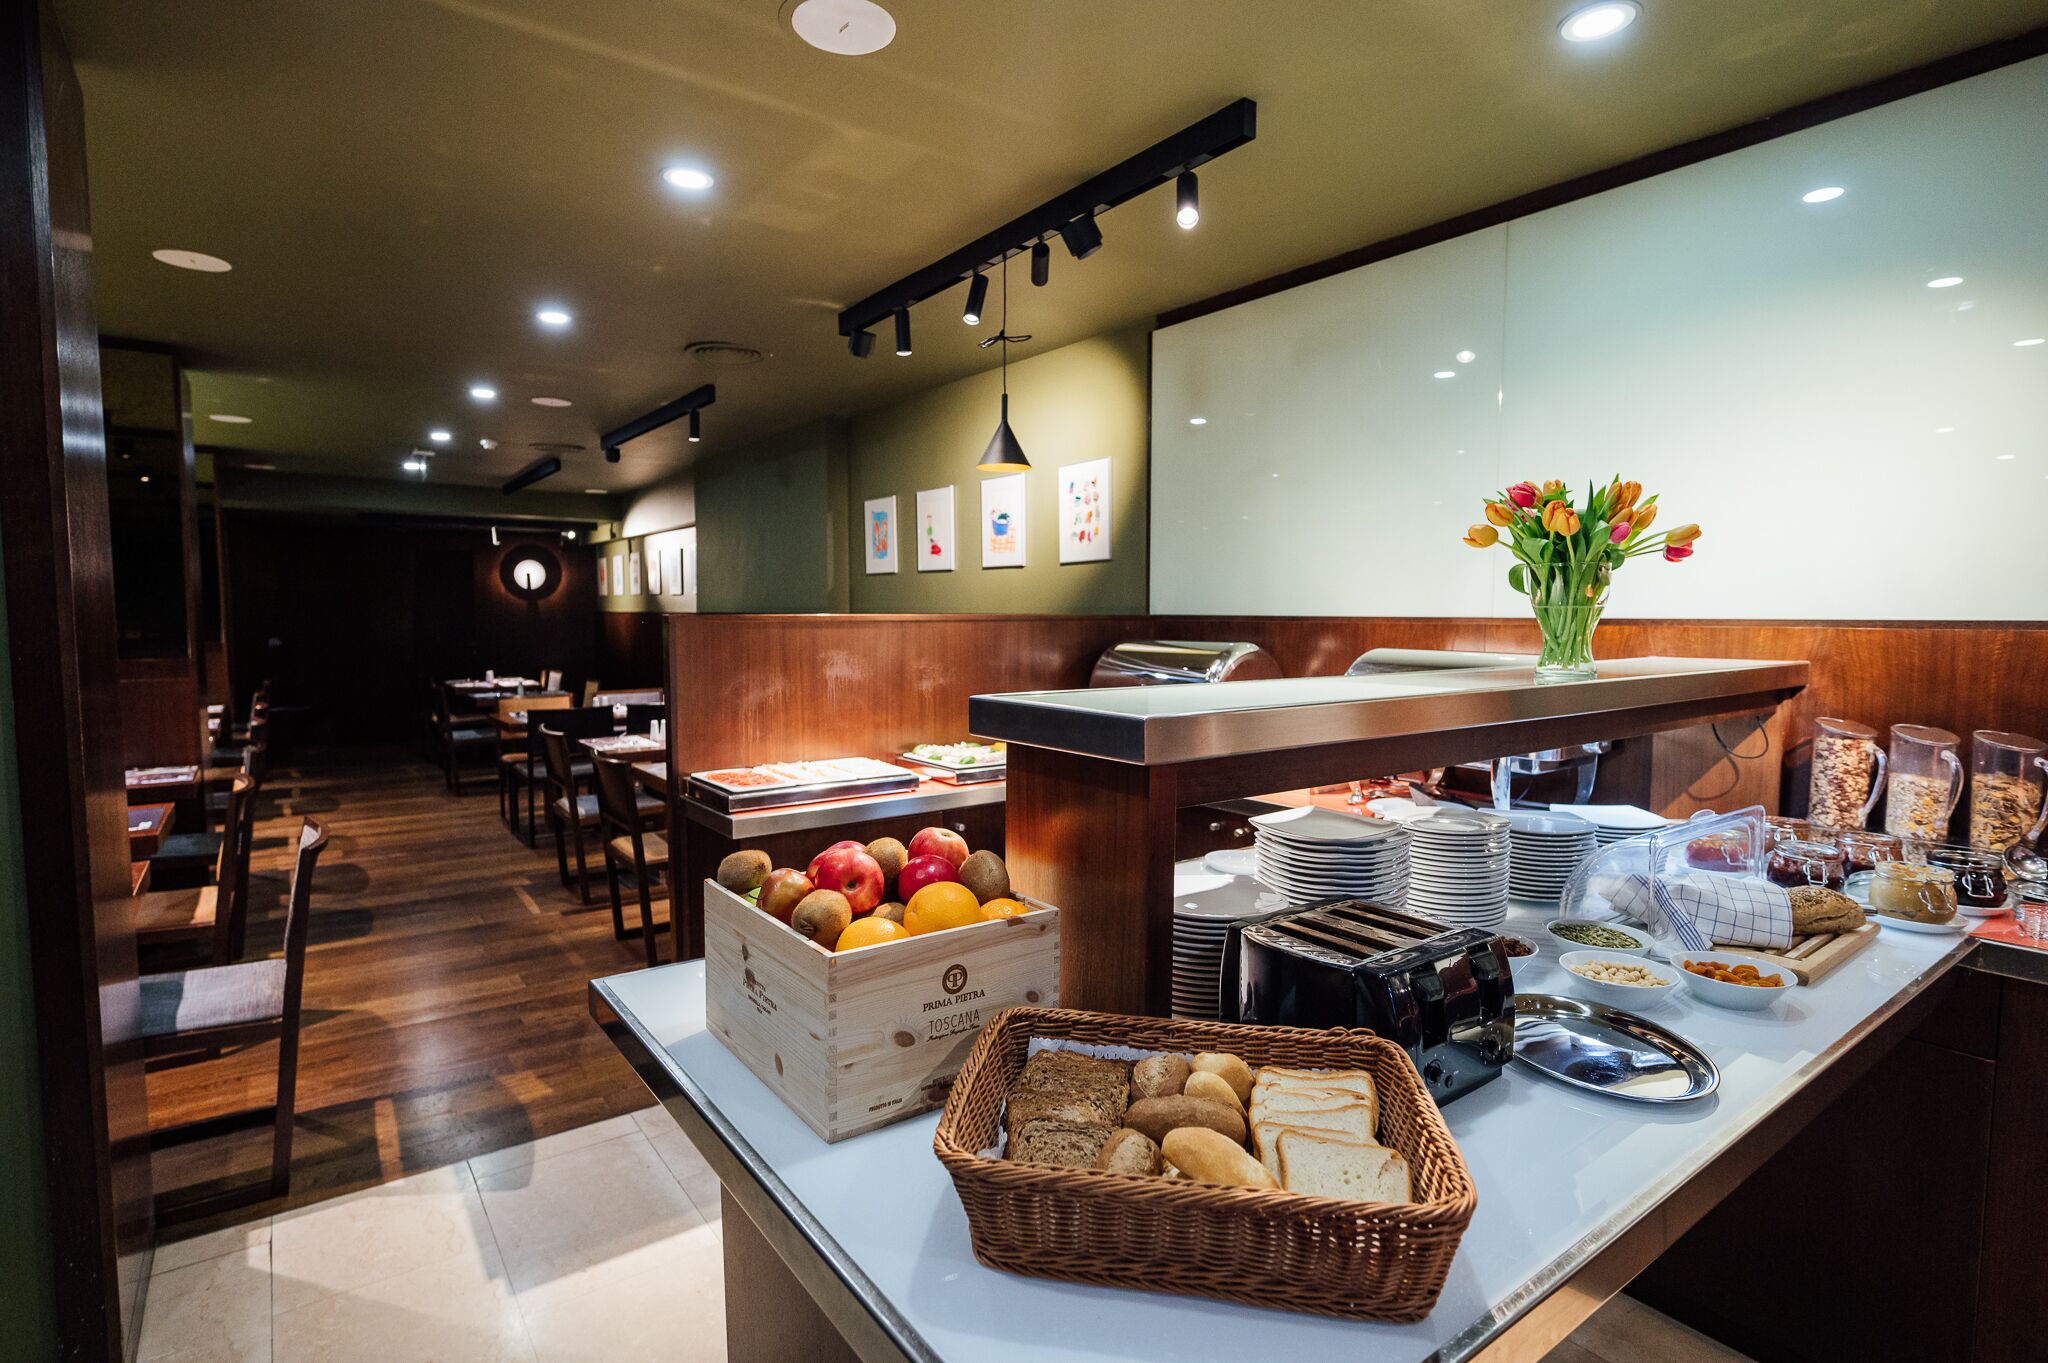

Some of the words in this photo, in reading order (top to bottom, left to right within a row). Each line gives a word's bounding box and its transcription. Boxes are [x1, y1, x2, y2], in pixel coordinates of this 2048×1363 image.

[923, 998, 952, 1012] PRIMA
[955, 989, 986, 1004] PIETRA
[929, 1008, 980, 1034] TOSCANA
